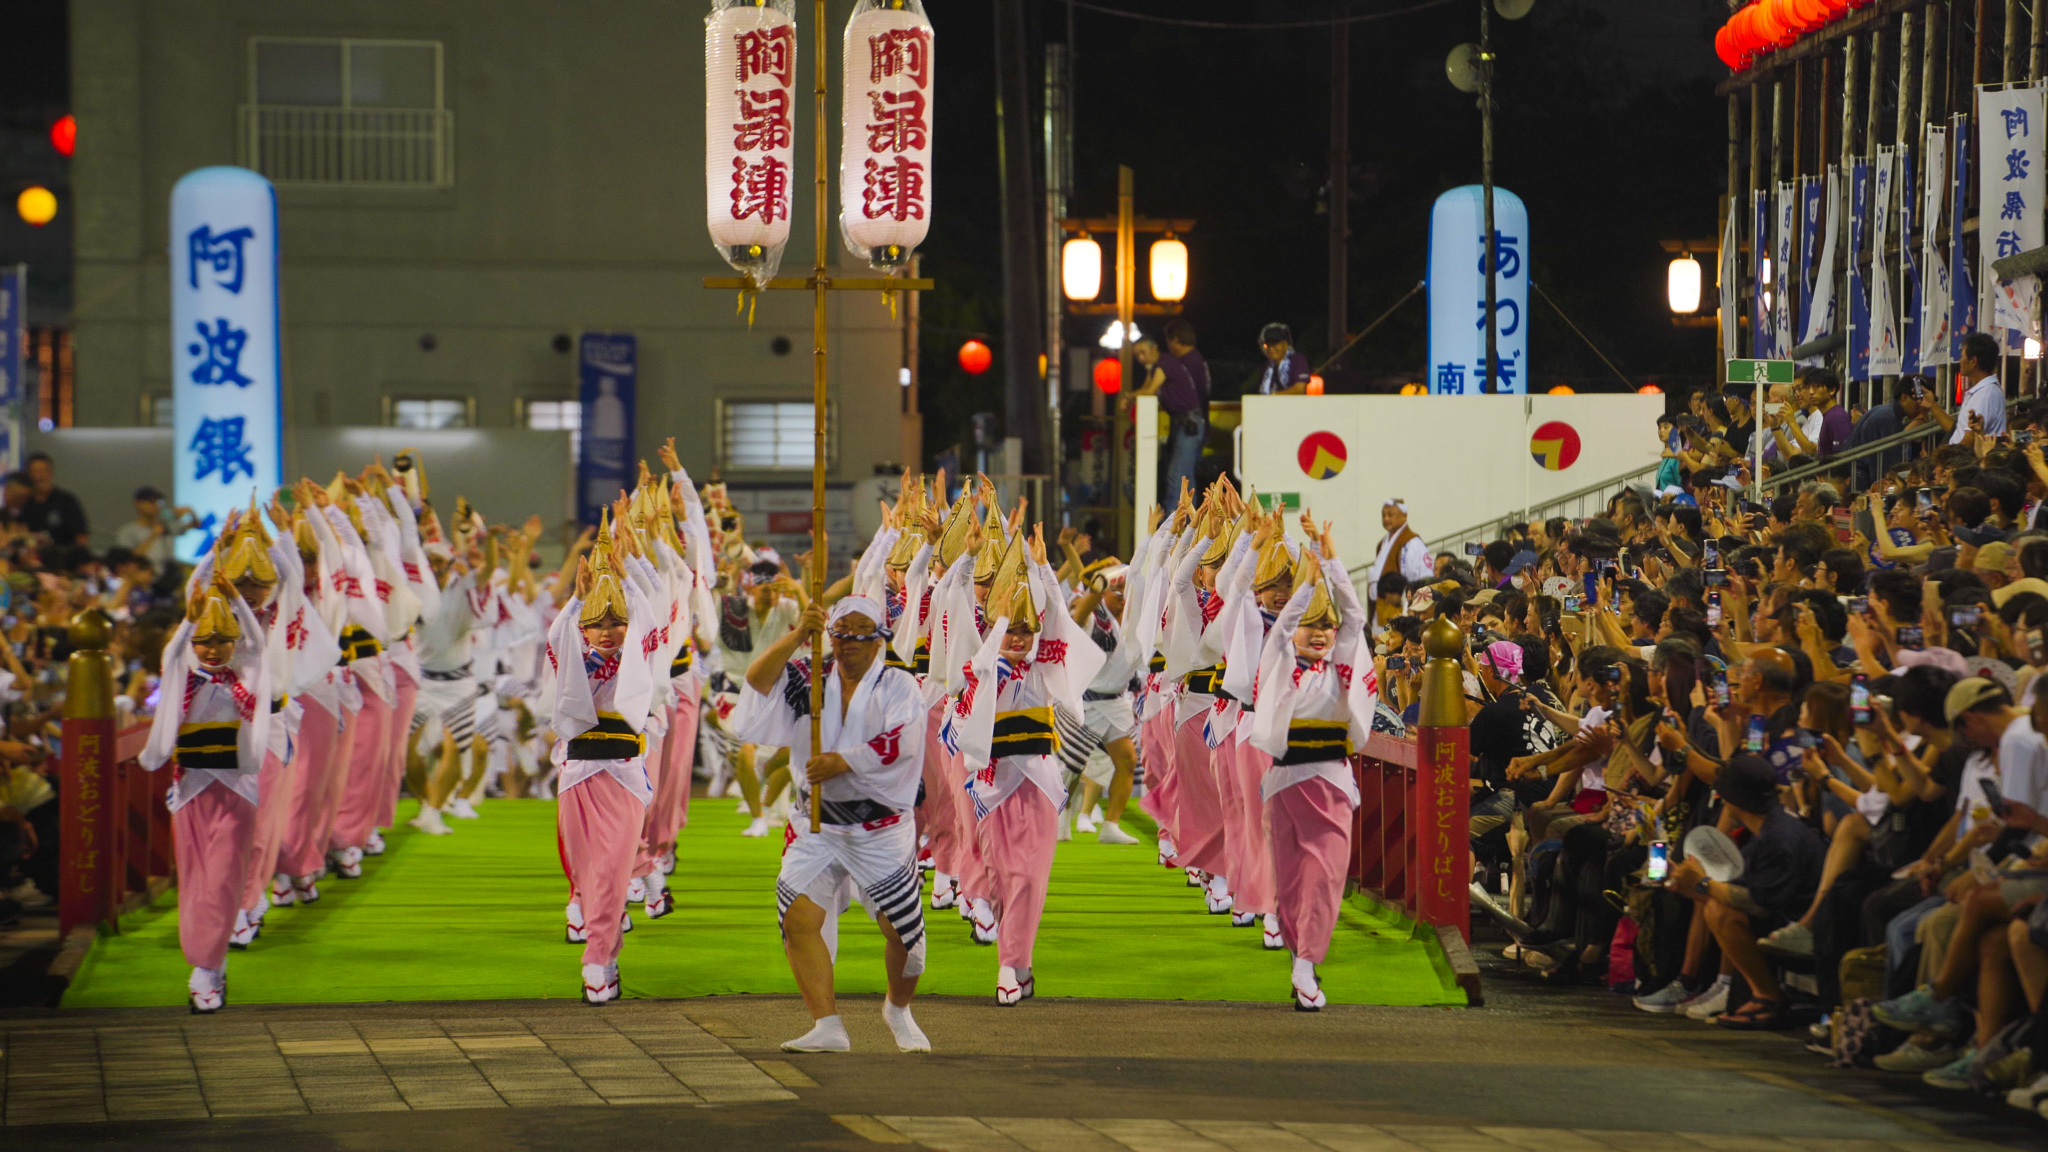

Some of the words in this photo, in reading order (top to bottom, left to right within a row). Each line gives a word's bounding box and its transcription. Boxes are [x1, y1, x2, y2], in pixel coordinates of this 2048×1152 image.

[1437, 362, 1466, 394] 南
[1434, 742, 1456, 897] 阿波おどりばし
